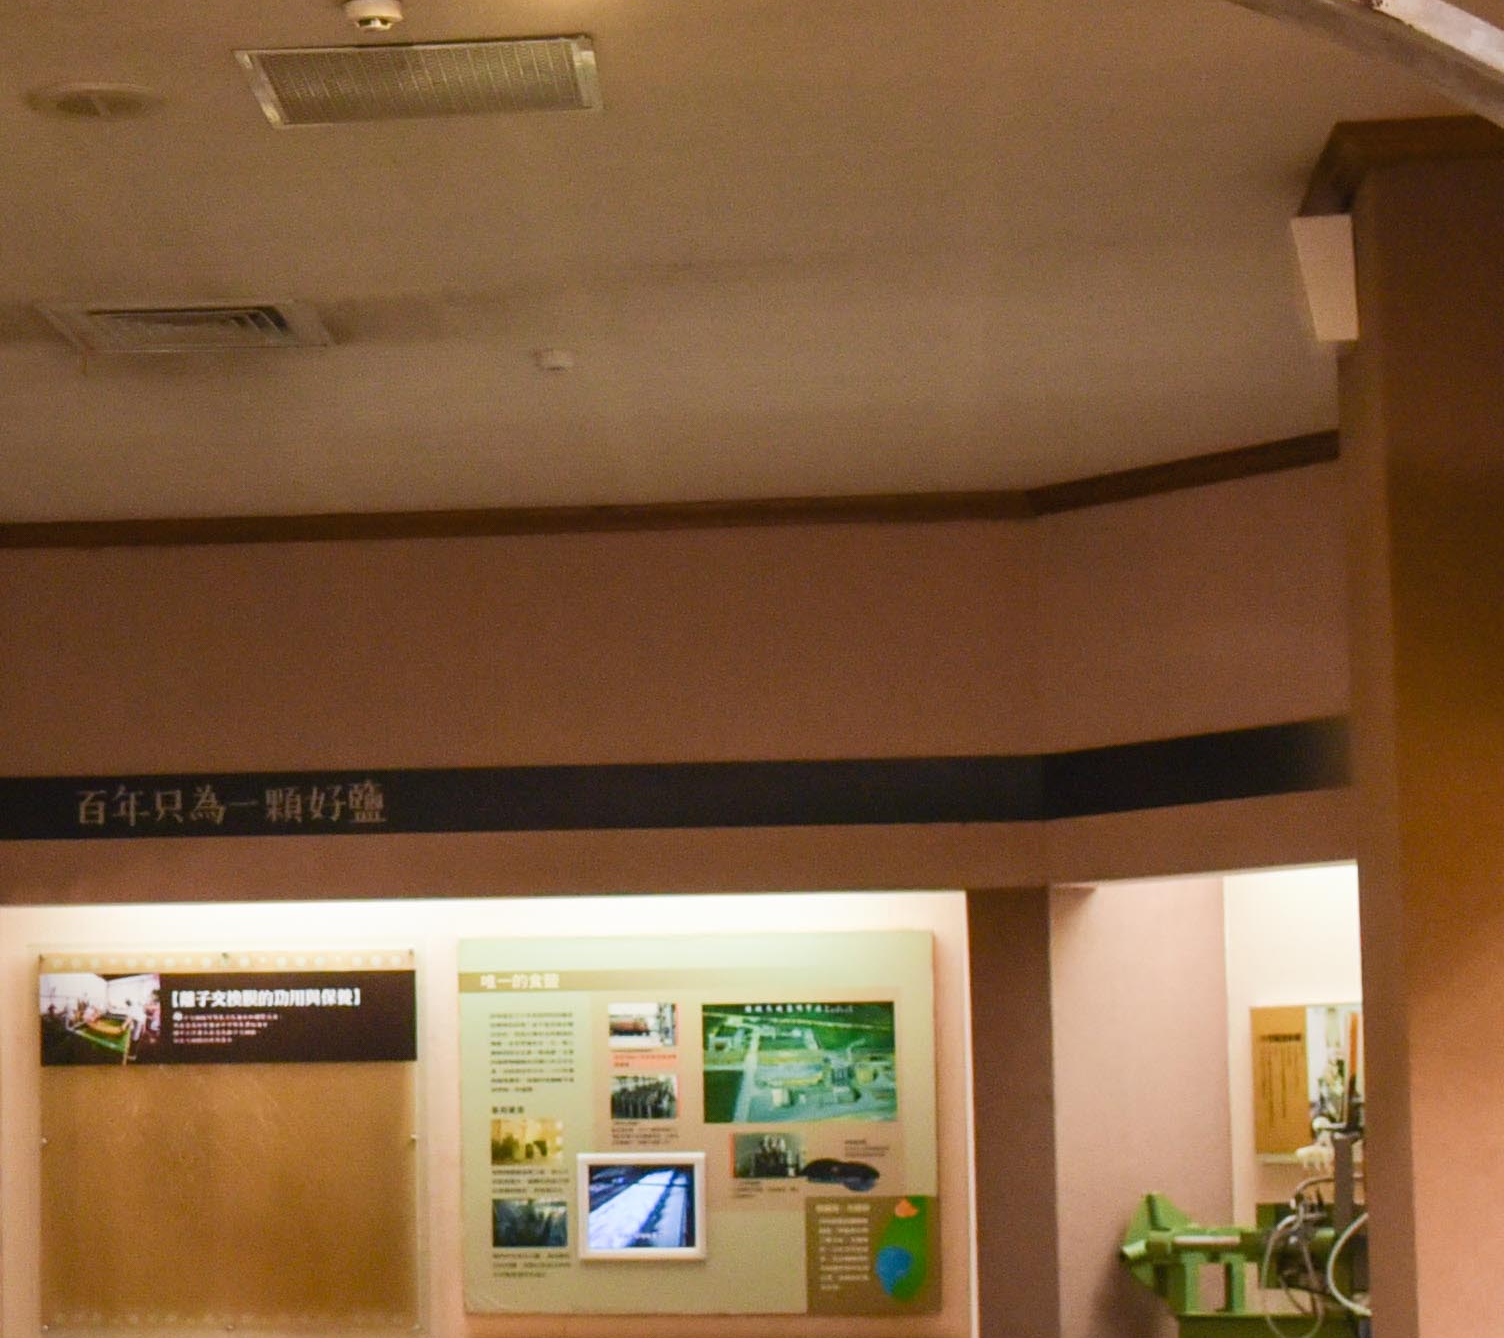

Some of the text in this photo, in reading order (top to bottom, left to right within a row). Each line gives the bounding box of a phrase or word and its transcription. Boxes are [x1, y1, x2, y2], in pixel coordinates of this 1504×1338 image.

[75, 778, 388, 827] 百年只為一顆好鹽
